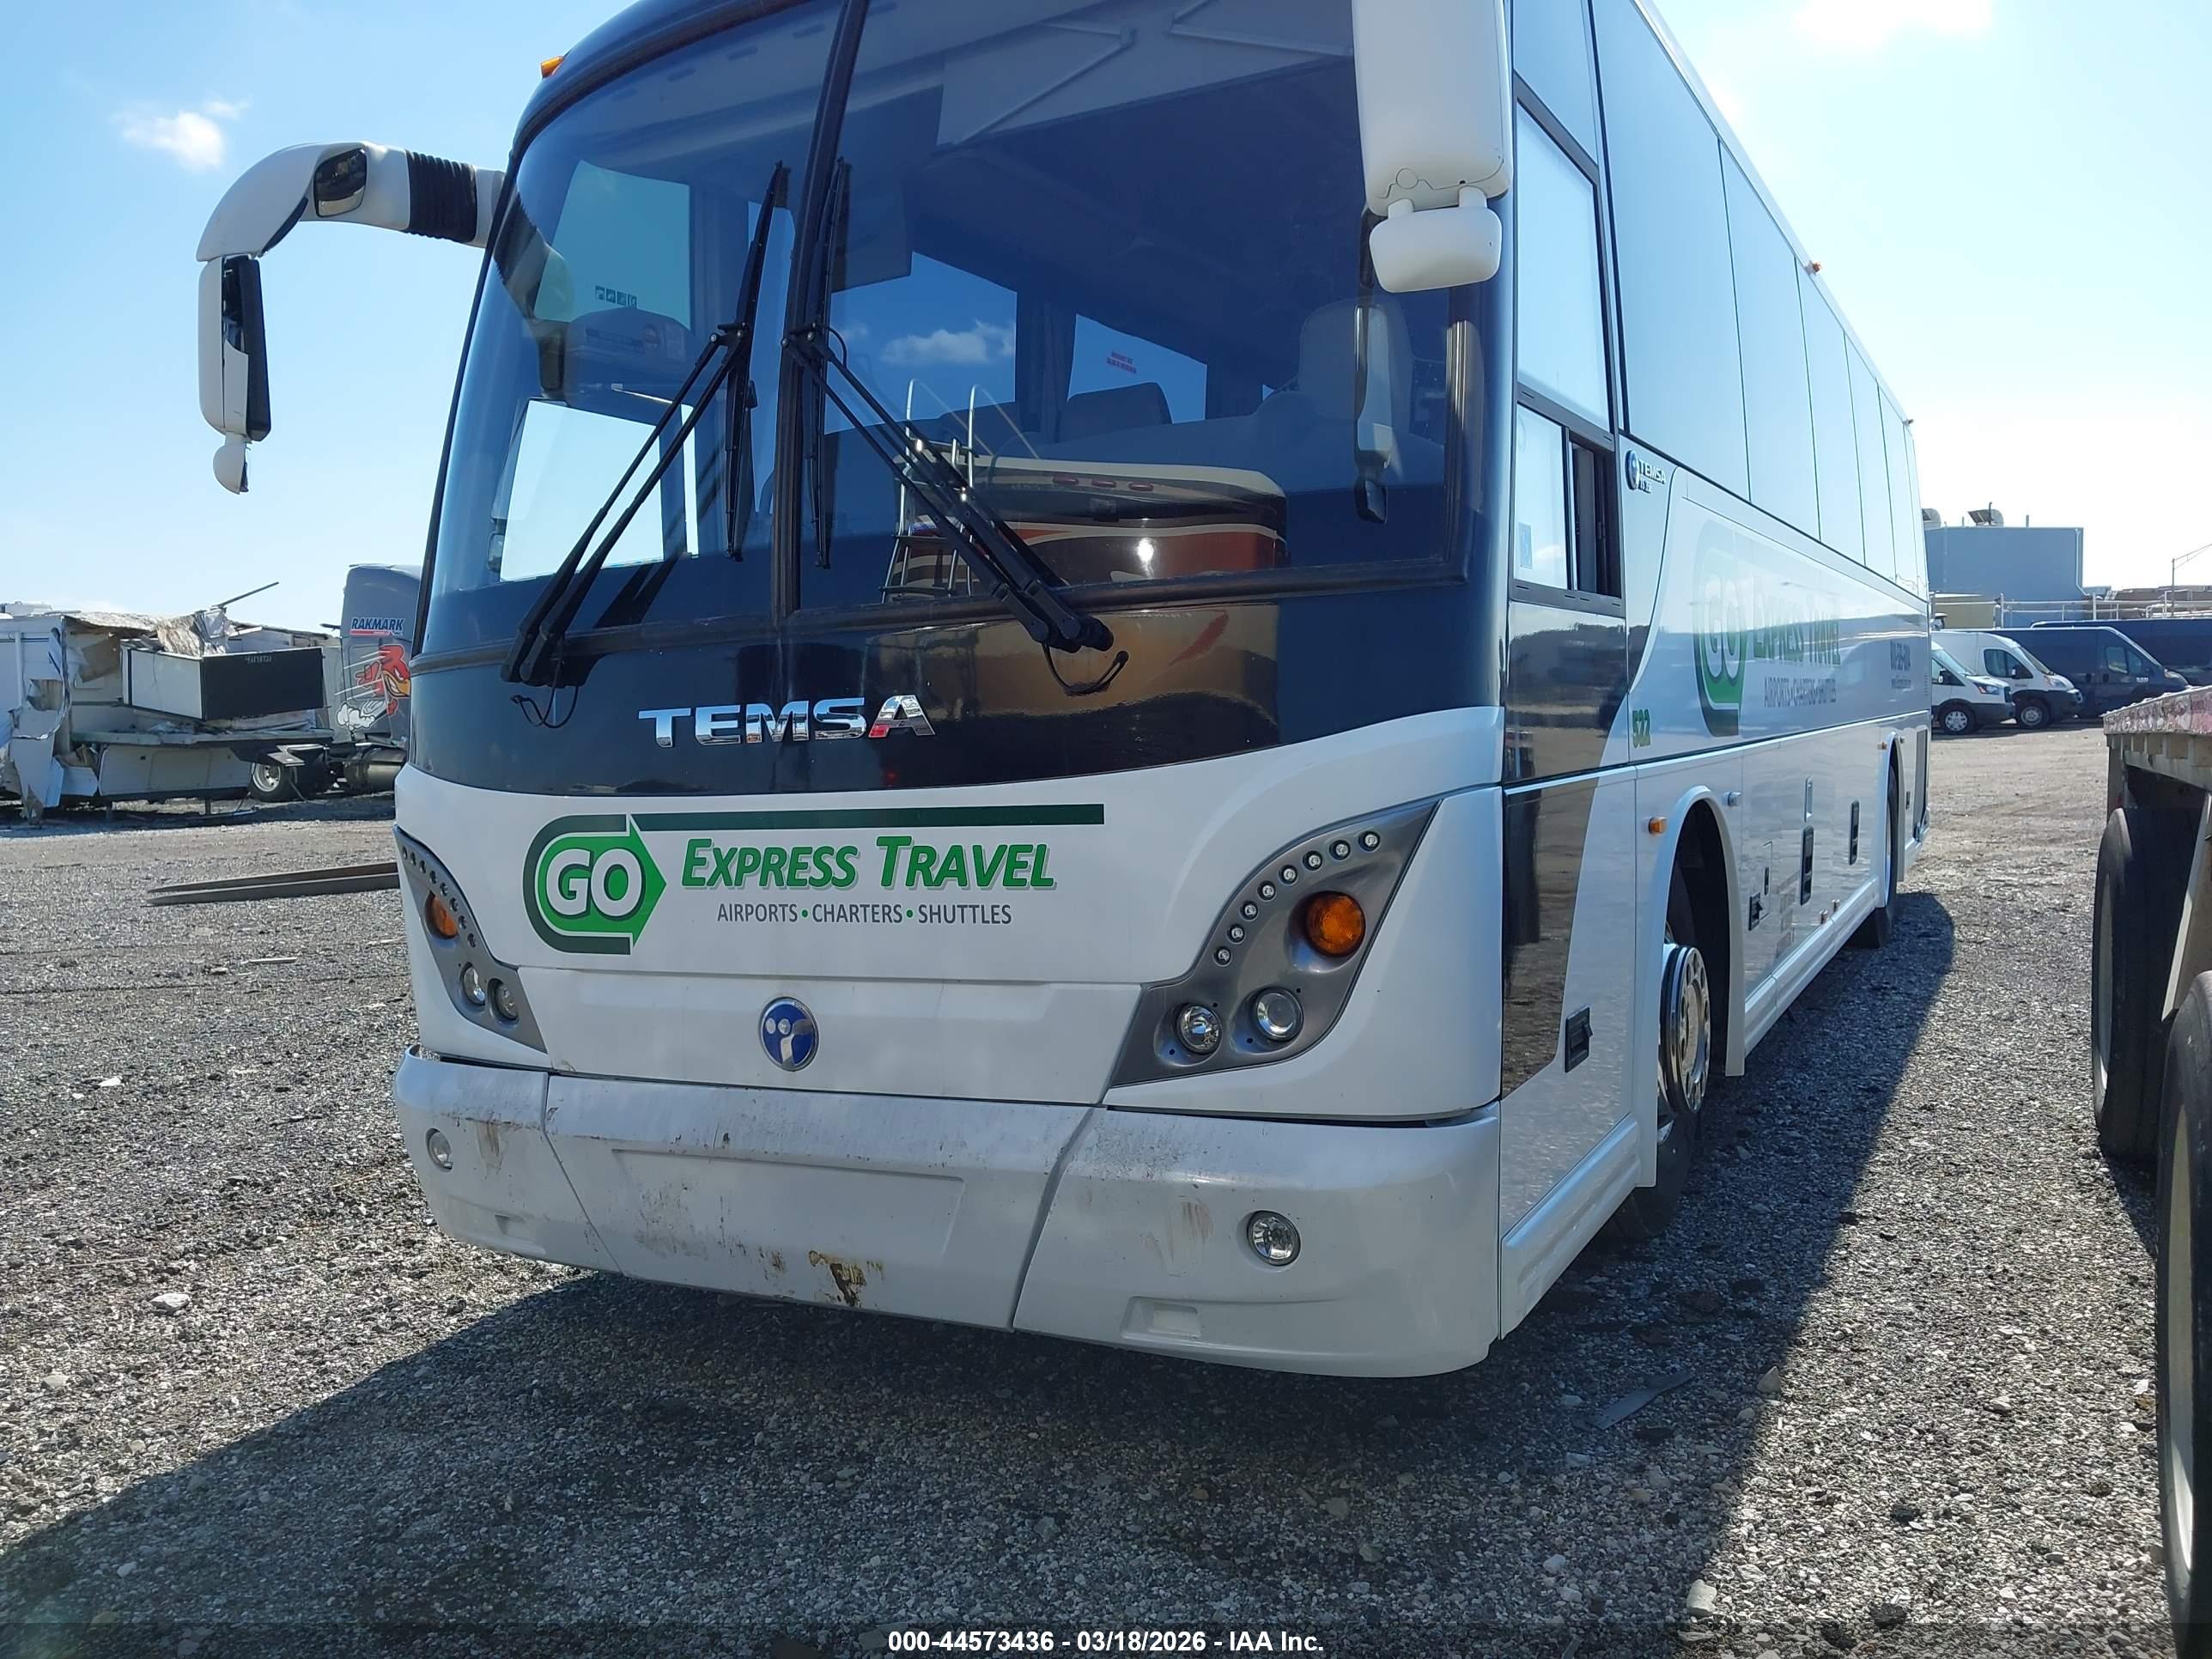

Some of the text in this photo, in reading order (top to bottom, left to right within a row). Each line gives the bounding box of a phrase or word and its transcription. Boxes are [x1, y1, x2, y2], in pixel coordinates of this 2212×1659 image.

[1638, 459, 1666, 484] TEMSA
[351, 617, 404, 630] RAKMARK
[1705, 577, 1740, 680] GO
[638, 695, 935, 747] TEMSA
[1632, 708, 1651, 748] 522
[544, 848, 643, 916] GO
[717, 902, 1012, 925] AIRPORTS CHARTERS SHUTTLES
